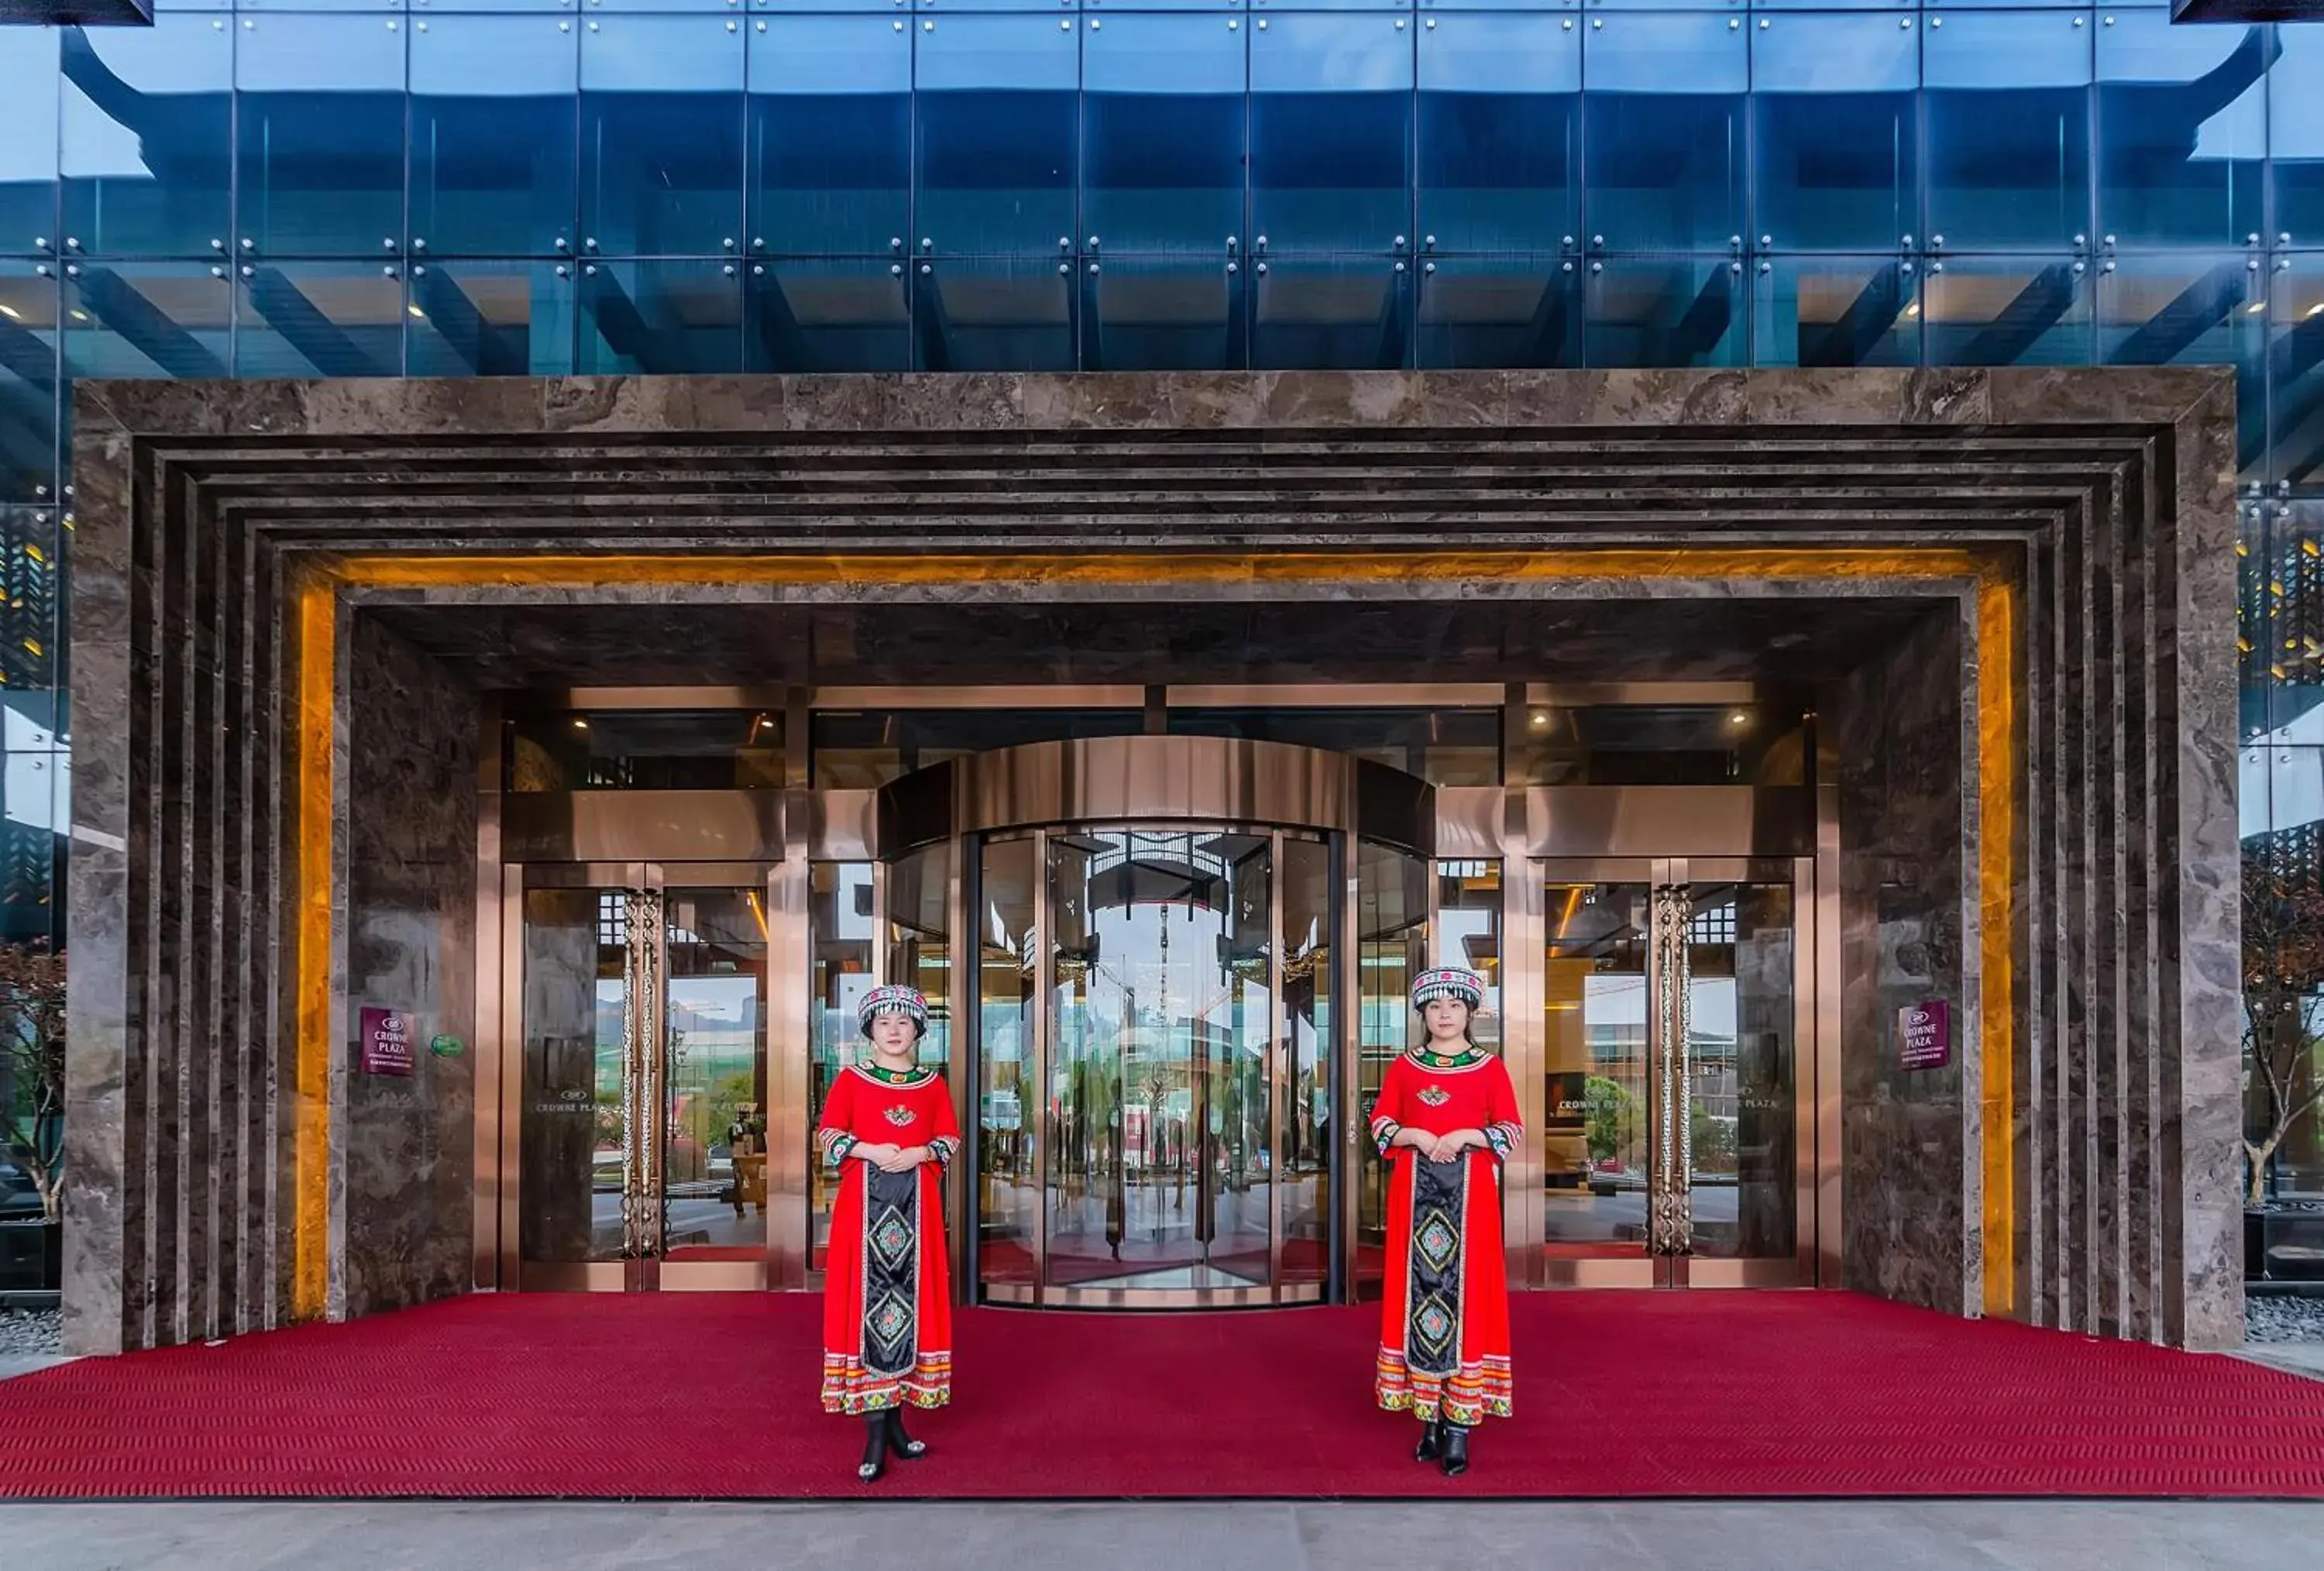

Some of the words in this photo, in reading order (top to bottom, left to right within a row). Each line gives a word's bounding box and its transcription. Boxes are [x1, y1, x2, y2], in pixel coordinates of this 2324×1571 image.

[374, 1031, 408, 1043] CROWNE
[1904, 1024, 1937, 1038] CROWNE
[379, 1042, 405, 1054] PLAZA
[1906, 1036, 1932, 1049] PLAZA
[535, 1102, 576, 1113] CROWNE
[1745, 1099, 1778, 1109] PLAZA
